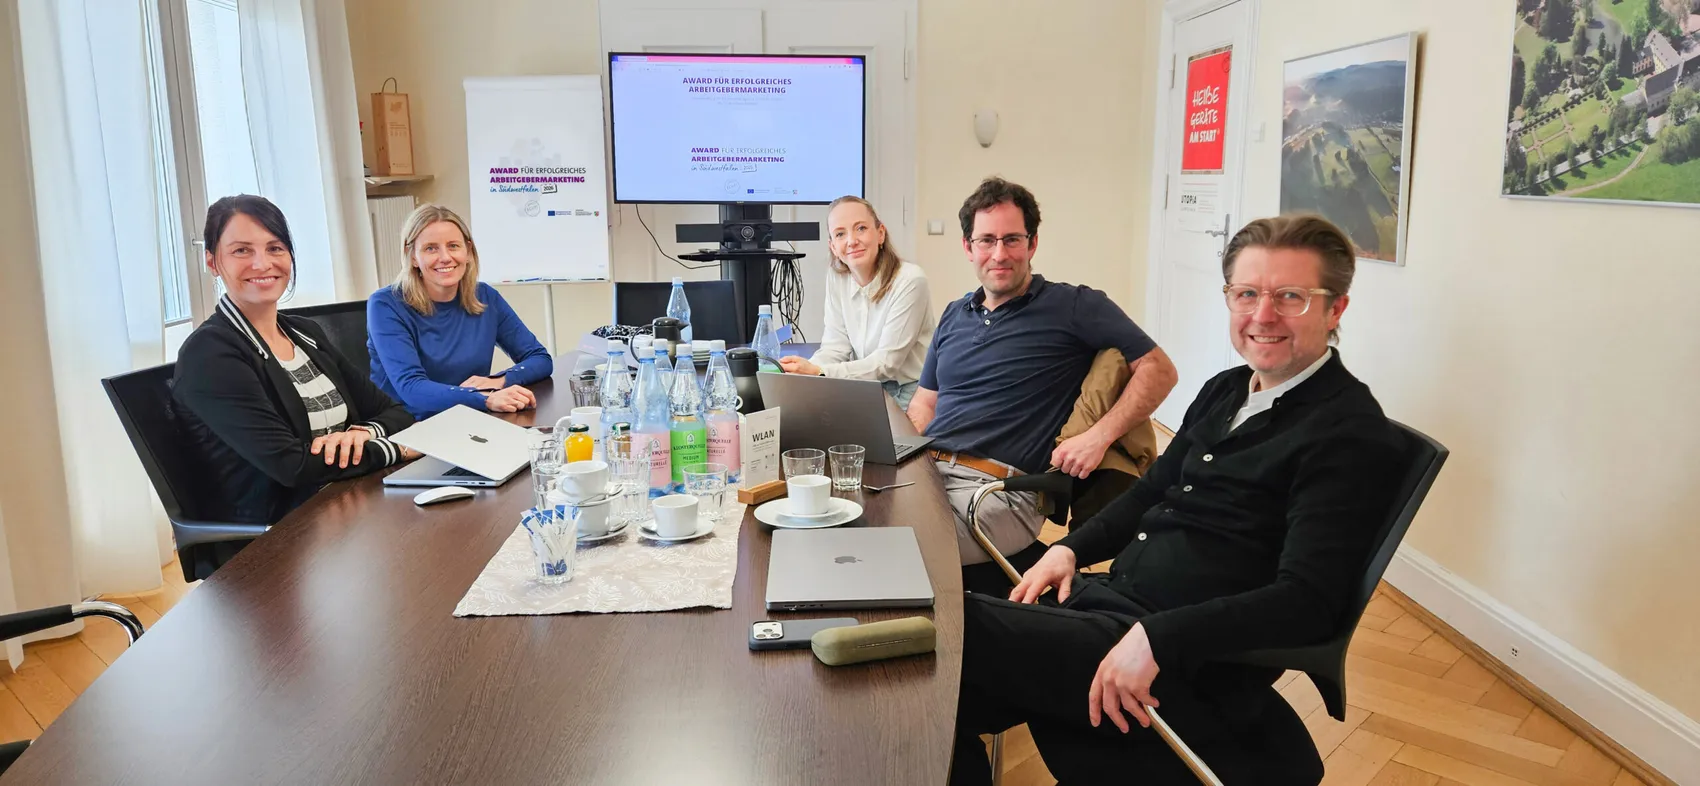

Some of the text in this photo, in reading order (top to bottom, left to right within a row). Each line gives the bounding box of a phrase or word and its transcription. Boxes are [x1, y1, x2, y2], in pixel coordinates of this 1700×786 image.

[714, 76, 730, 84] FÜR
[1190, 108, 1218, 130] GERÄTE
[1189, 130, 1200, 144] AM
[520, 166, 534, 174] FÜR
[700, 164, 739, 172] Südwestfalen
[498, 184, 540, 193] Südwestfalen
[752, 430, 774, 442] WLAN
